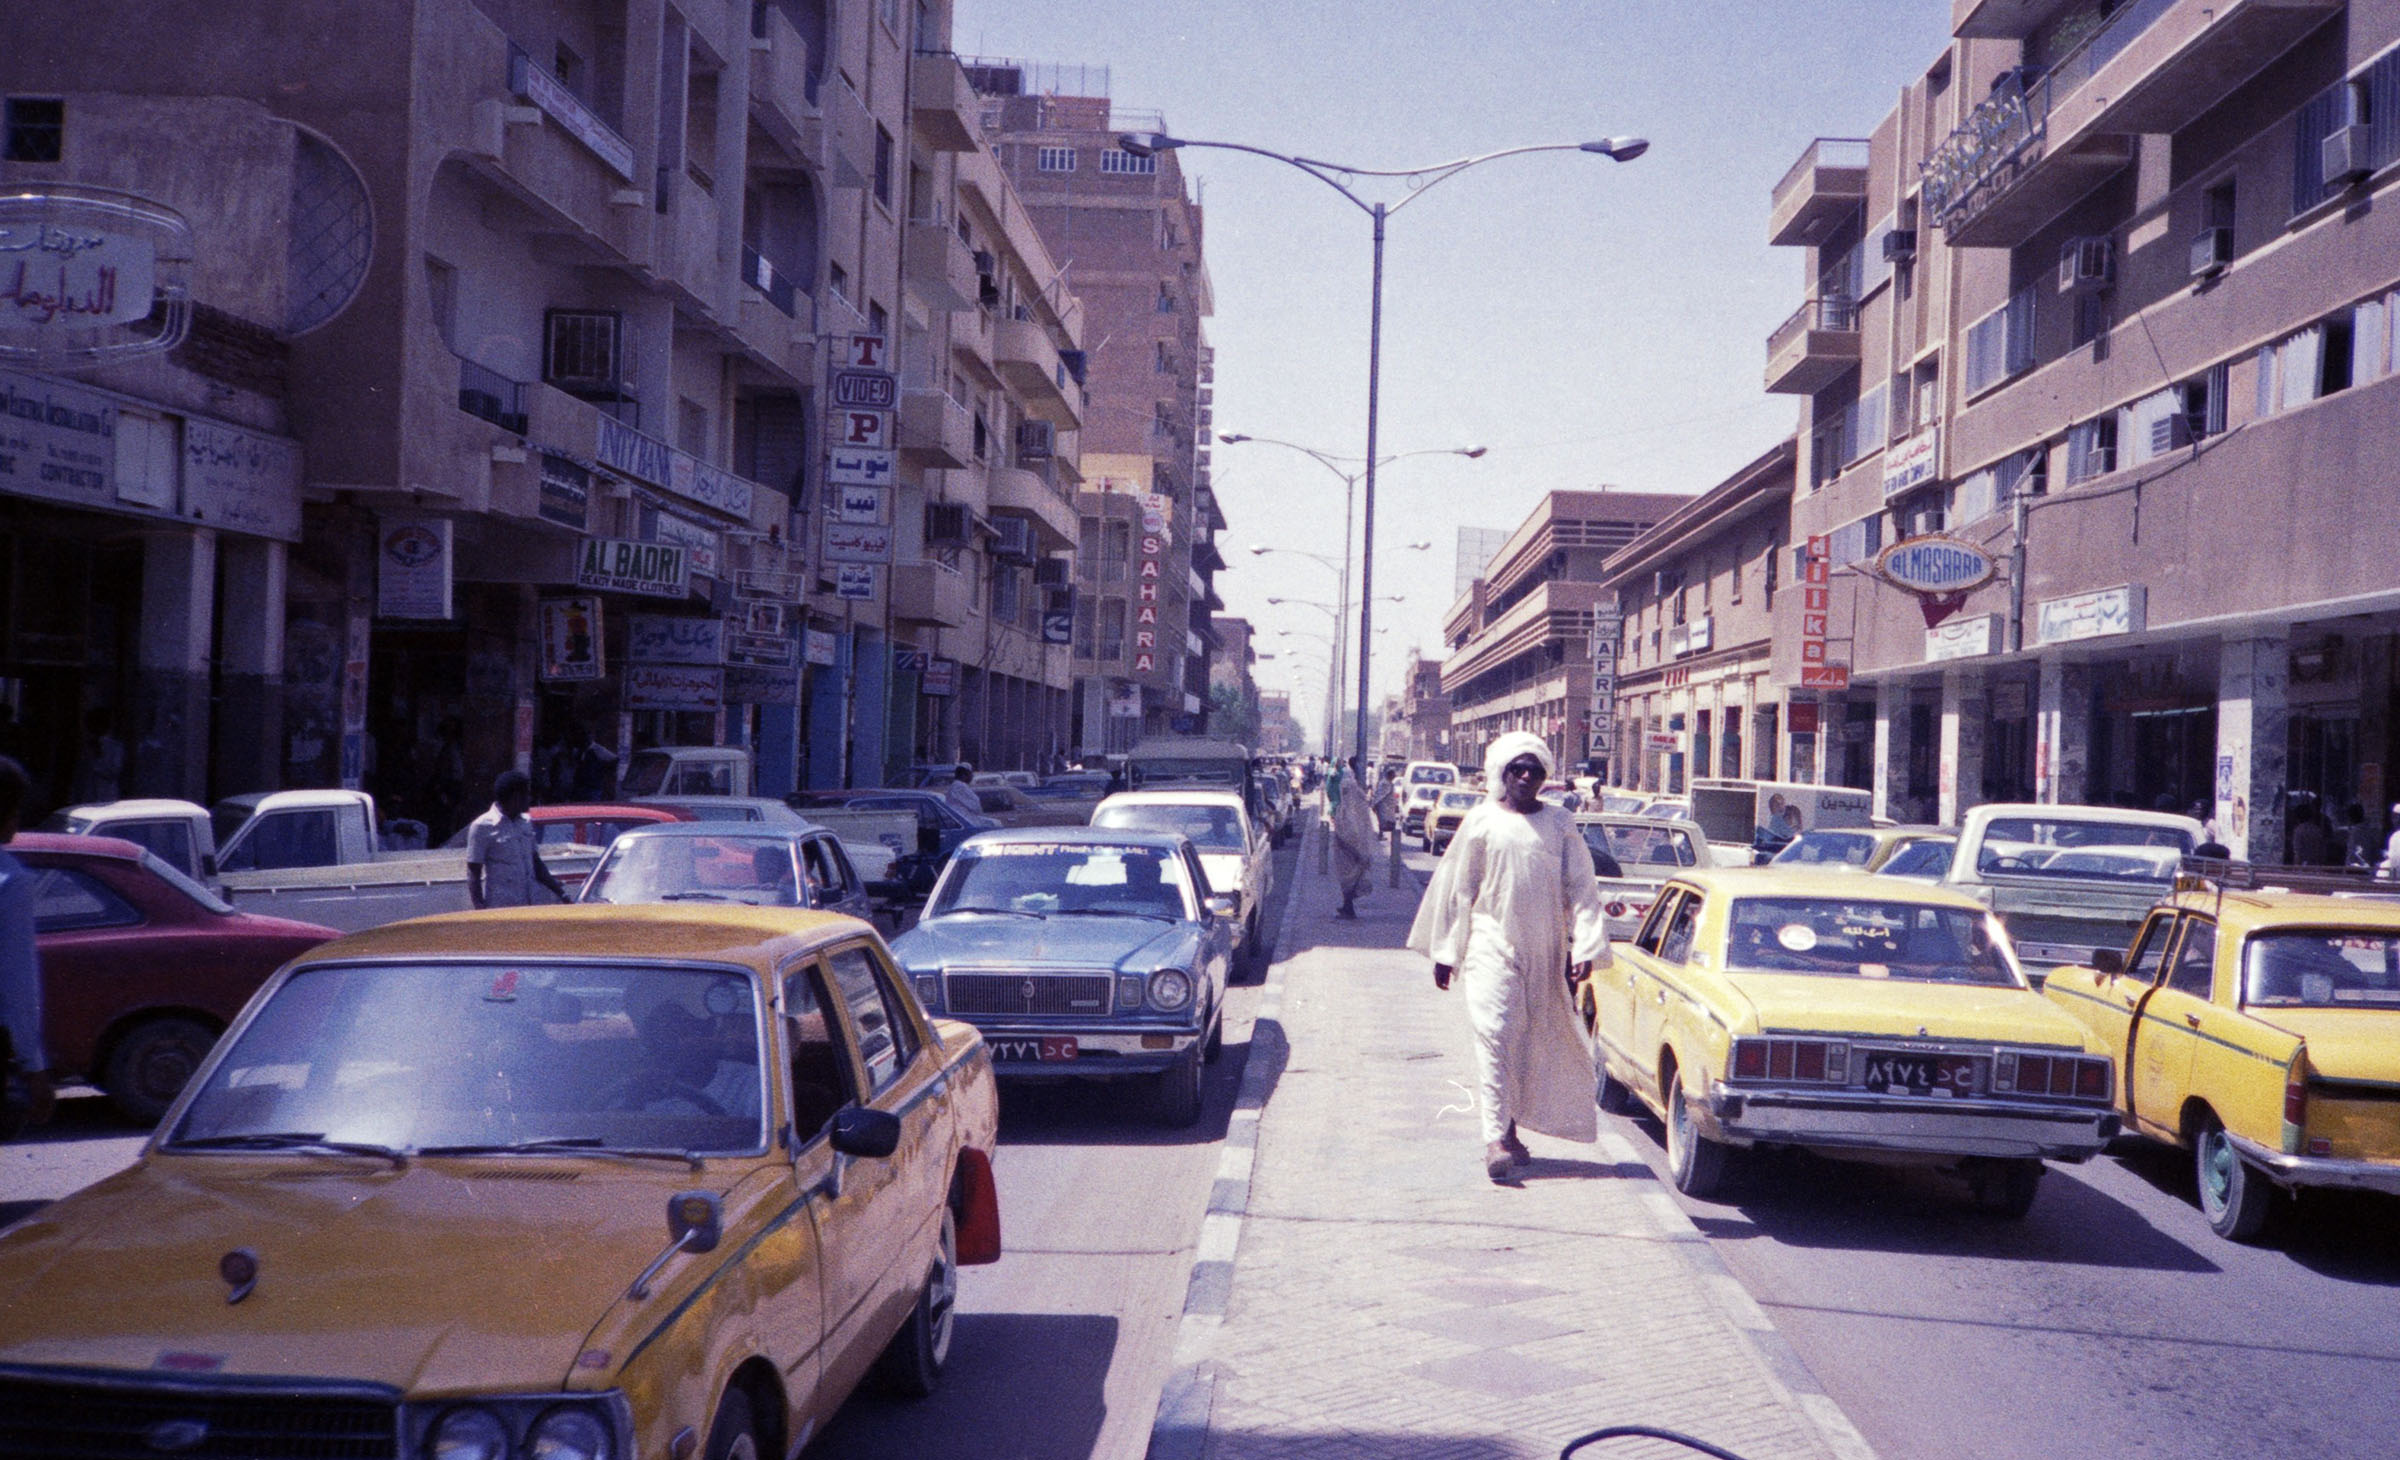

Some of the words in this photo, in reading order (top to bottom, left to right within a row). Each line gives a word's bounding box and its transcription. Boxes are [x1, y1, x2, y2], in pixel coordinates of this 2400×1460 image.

[853, 336, 883, 366] T
[841, 378, 890, 402] VIDEO
[848, 413, 879, 443] P
[583, 540, 611, 575] AL
[615, 543, 681, 583] BADRI
[1891, 546, 1982, 584] ALMASARRA
[581, 574, 609, 586] READY
[612, 578, 638, 591] MADE
[640, 581, 682, 596] CLOTHES
[1136, 537, 1160, 671] SAHARA
[1592, 642, 1611, 748] AFRICA
